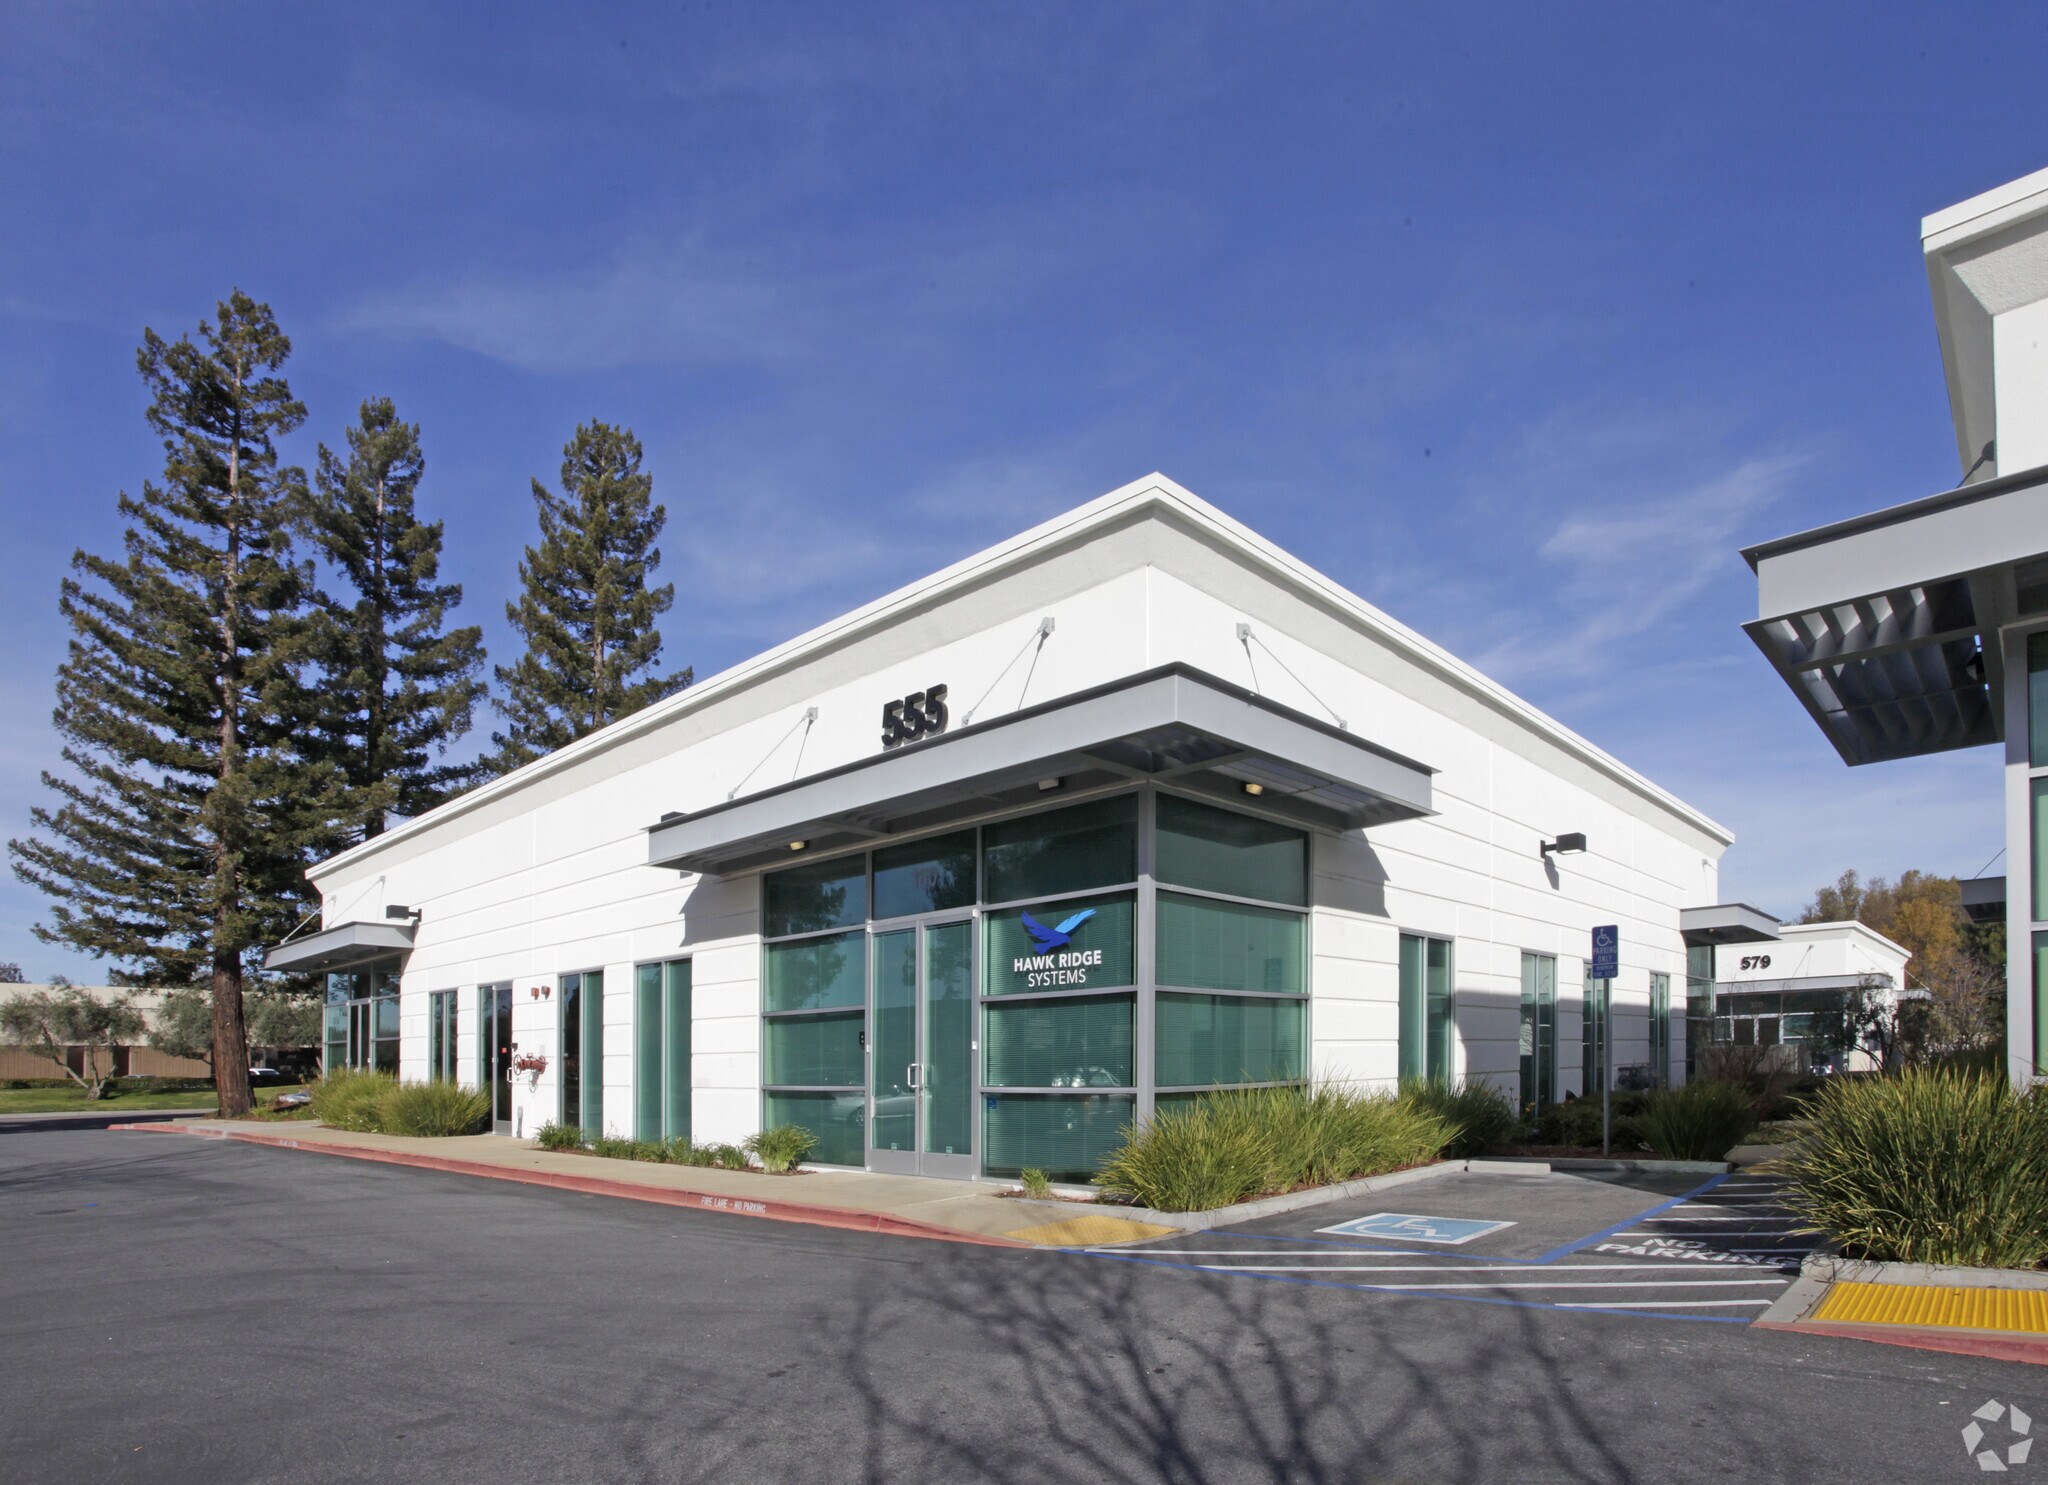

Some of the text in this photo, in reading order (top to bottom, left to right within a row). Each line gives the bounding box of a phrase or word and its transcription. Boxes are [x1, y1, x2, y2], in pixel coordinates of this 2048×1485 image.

[881, 683, 949, 747] 555
[1593, 946, 1617, 955] PARKING
[1597, 954, 1612, 963] ONLY
[1014, 950, 1102, 972] HAWK RIDGE
[1740, 955, 1771, 971] 579
[1028, 968, 1086, 987] SYSTEMS
[702, 1196, 713, 1206] FIRE
[714, 1198, 728, 1208] LANE
[734, 1201, 742, 1210] NO
[743, 1202, 766, 1213] PARKING
[1642, 1238, 1707, 1249] NO
[1594, 1243, 1801, 1266] PARKING
